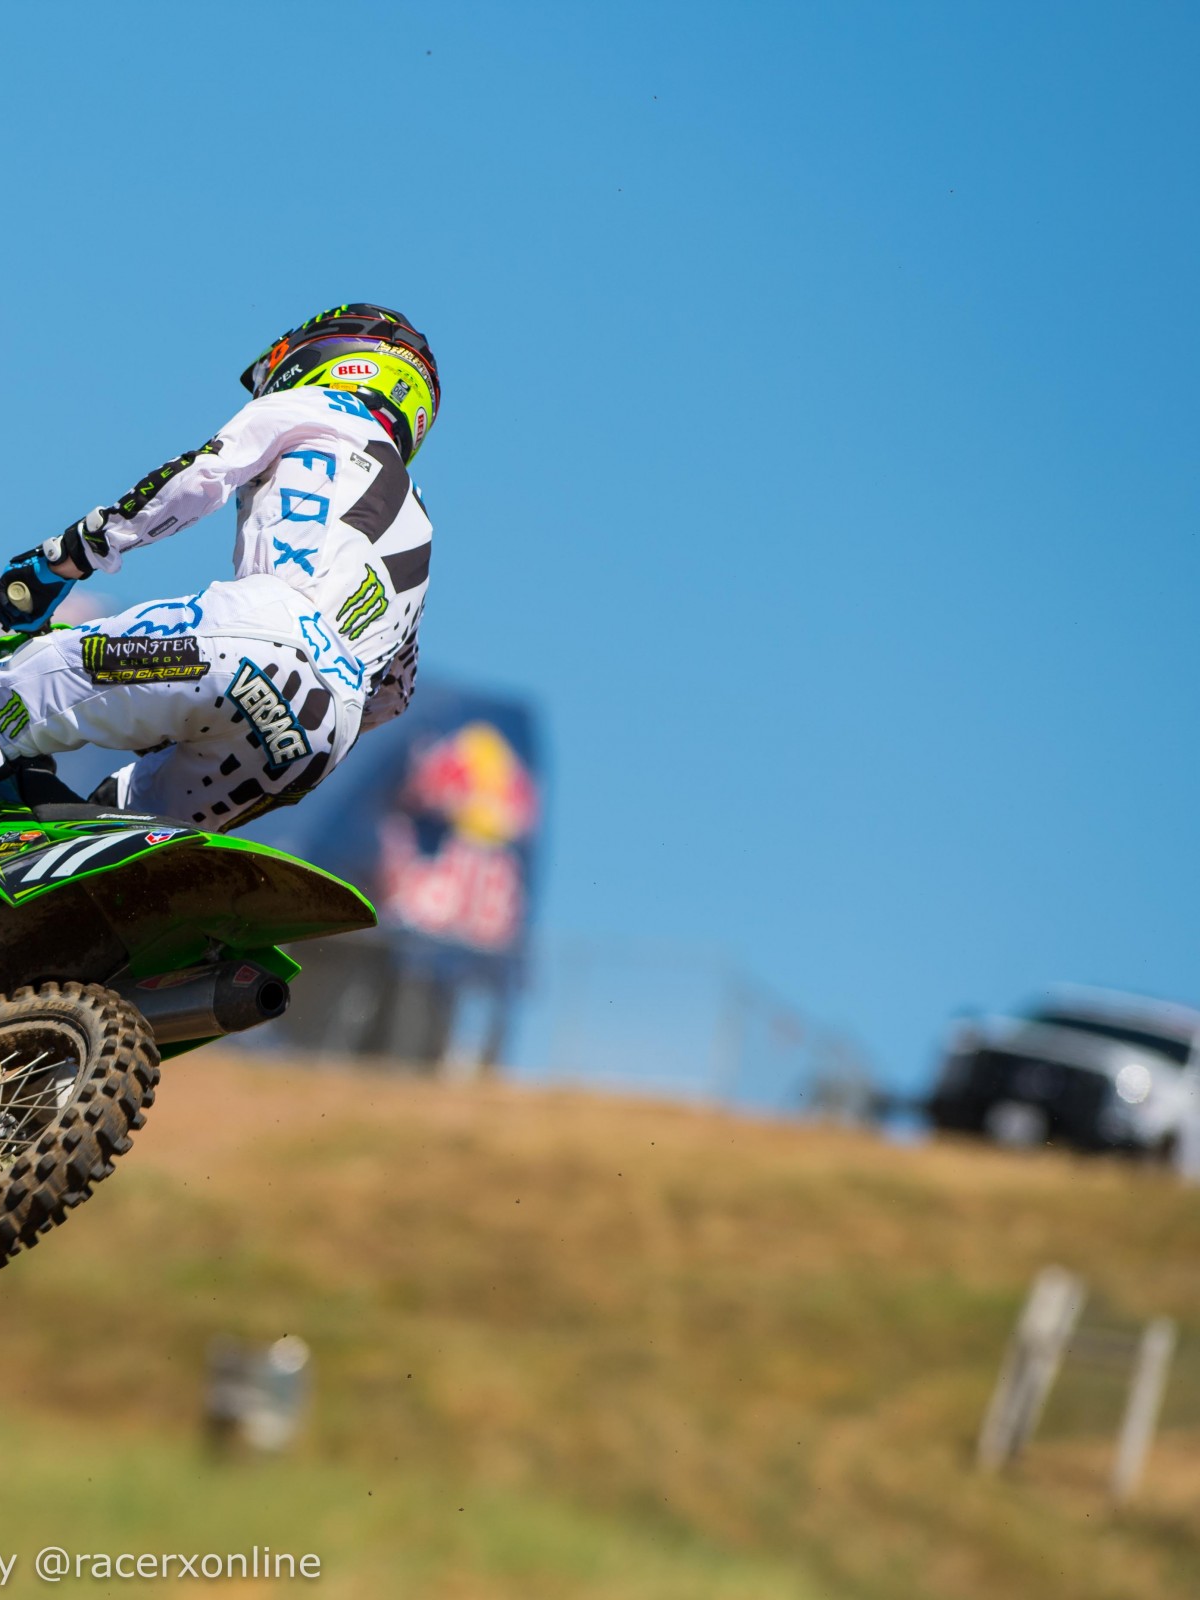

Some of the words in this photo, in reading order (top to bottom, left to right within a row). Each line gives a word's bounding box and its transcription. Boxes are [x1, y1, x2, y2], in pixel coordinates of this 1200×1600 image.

[338, 365, 372, 375] BELL
[273, 450, 337, 577] FOX
[106, 637, 197, 658] MONSTER
[120, 655, 183, 666] ENERGY
[97, 669, 134, 681] PRO
[135, 665, 206, 680] CIRCUIT
[231, 665, 308, 765] VERSACE
